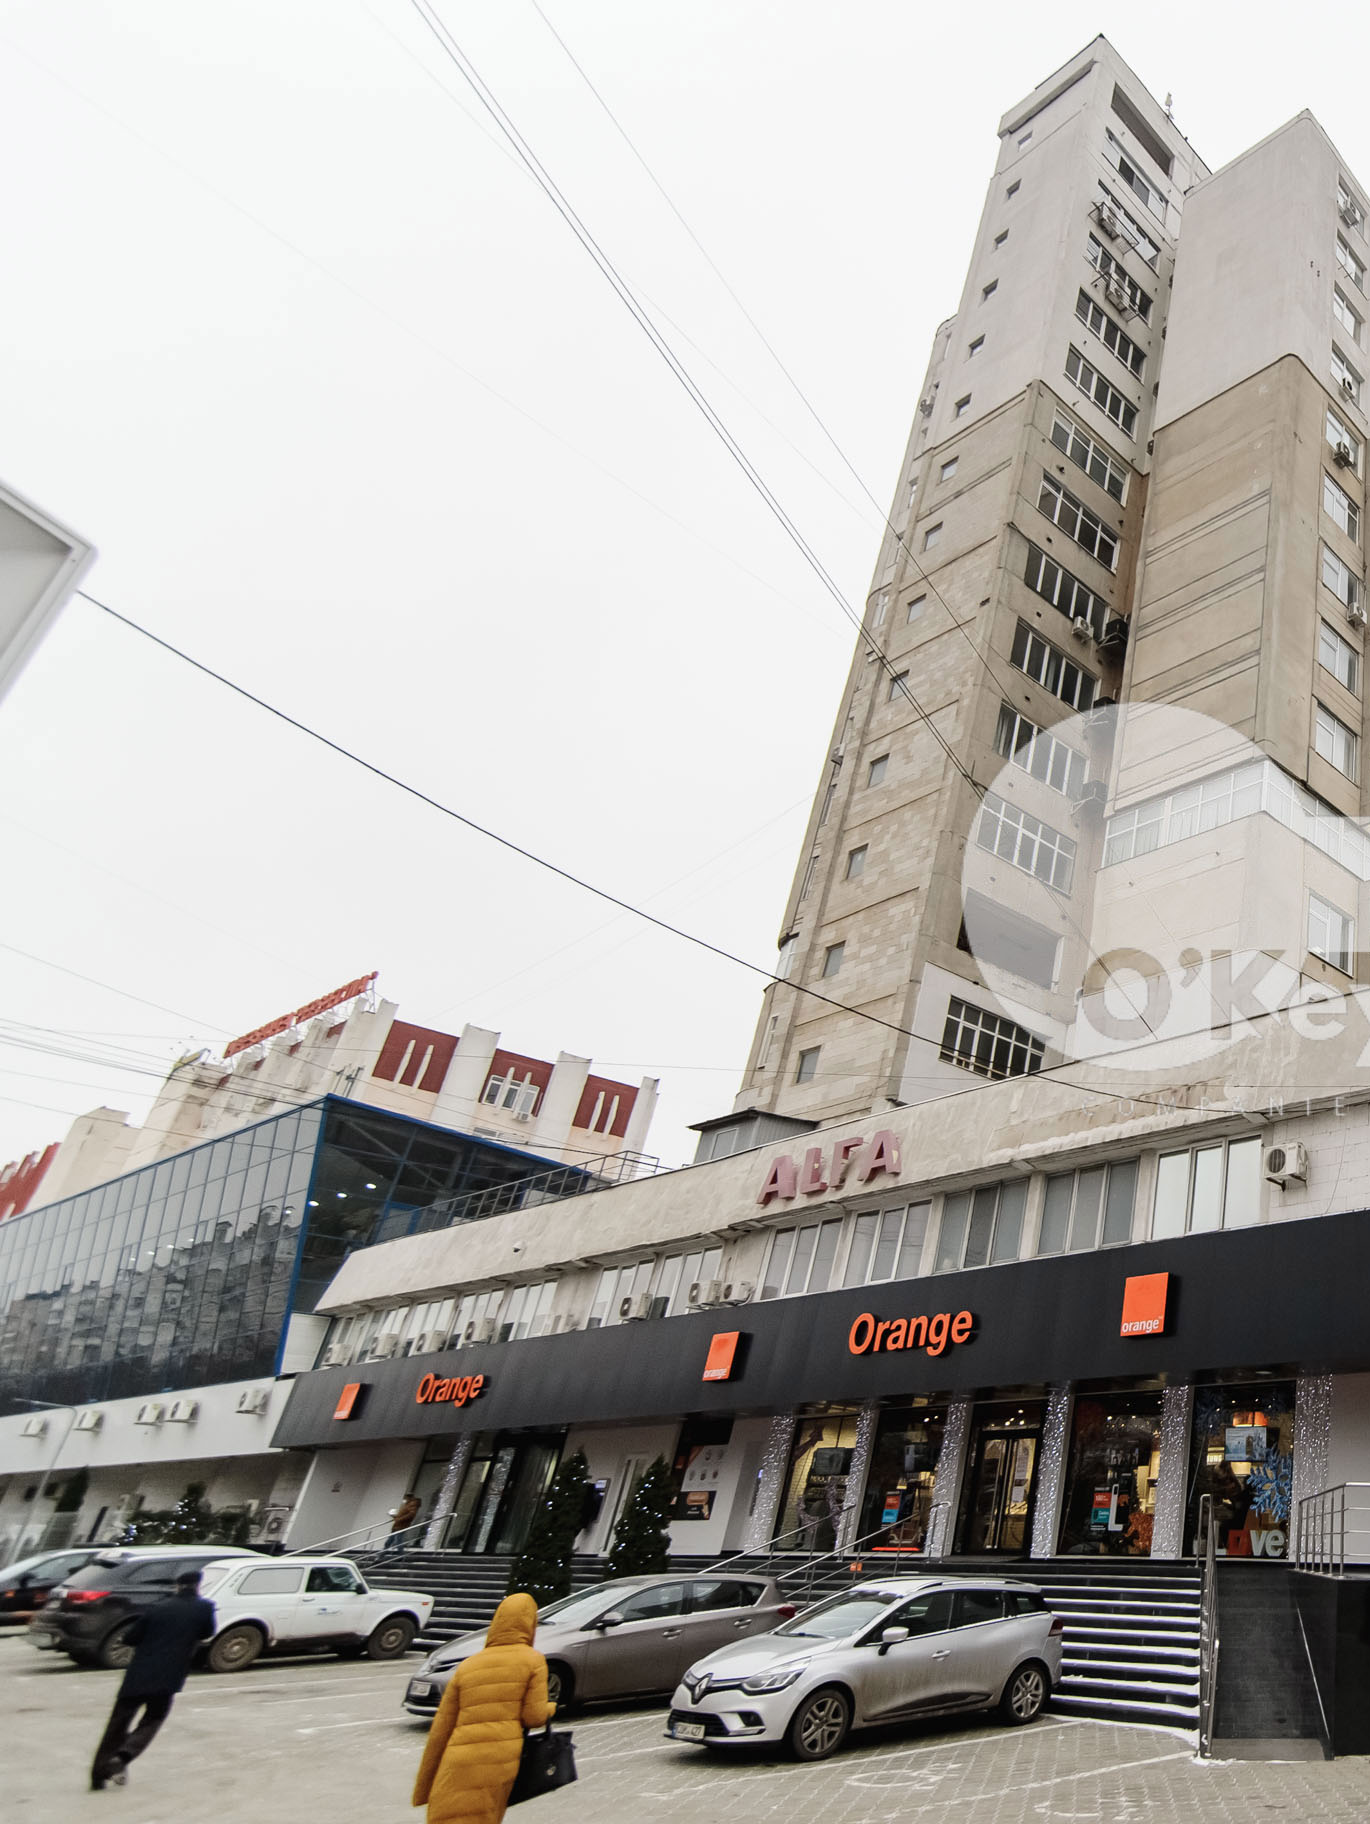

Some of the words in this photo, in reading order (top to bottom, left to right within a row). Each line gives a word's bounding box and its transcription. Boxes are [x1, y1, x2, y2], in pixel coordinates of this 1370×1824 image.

[756, 1129, 902, 1204] ALFA
[848, 1310, 973, 1357] Orange
[1121, 1319, 1160, 1334] orange
[416, 1372, 485, 1408] Orange
